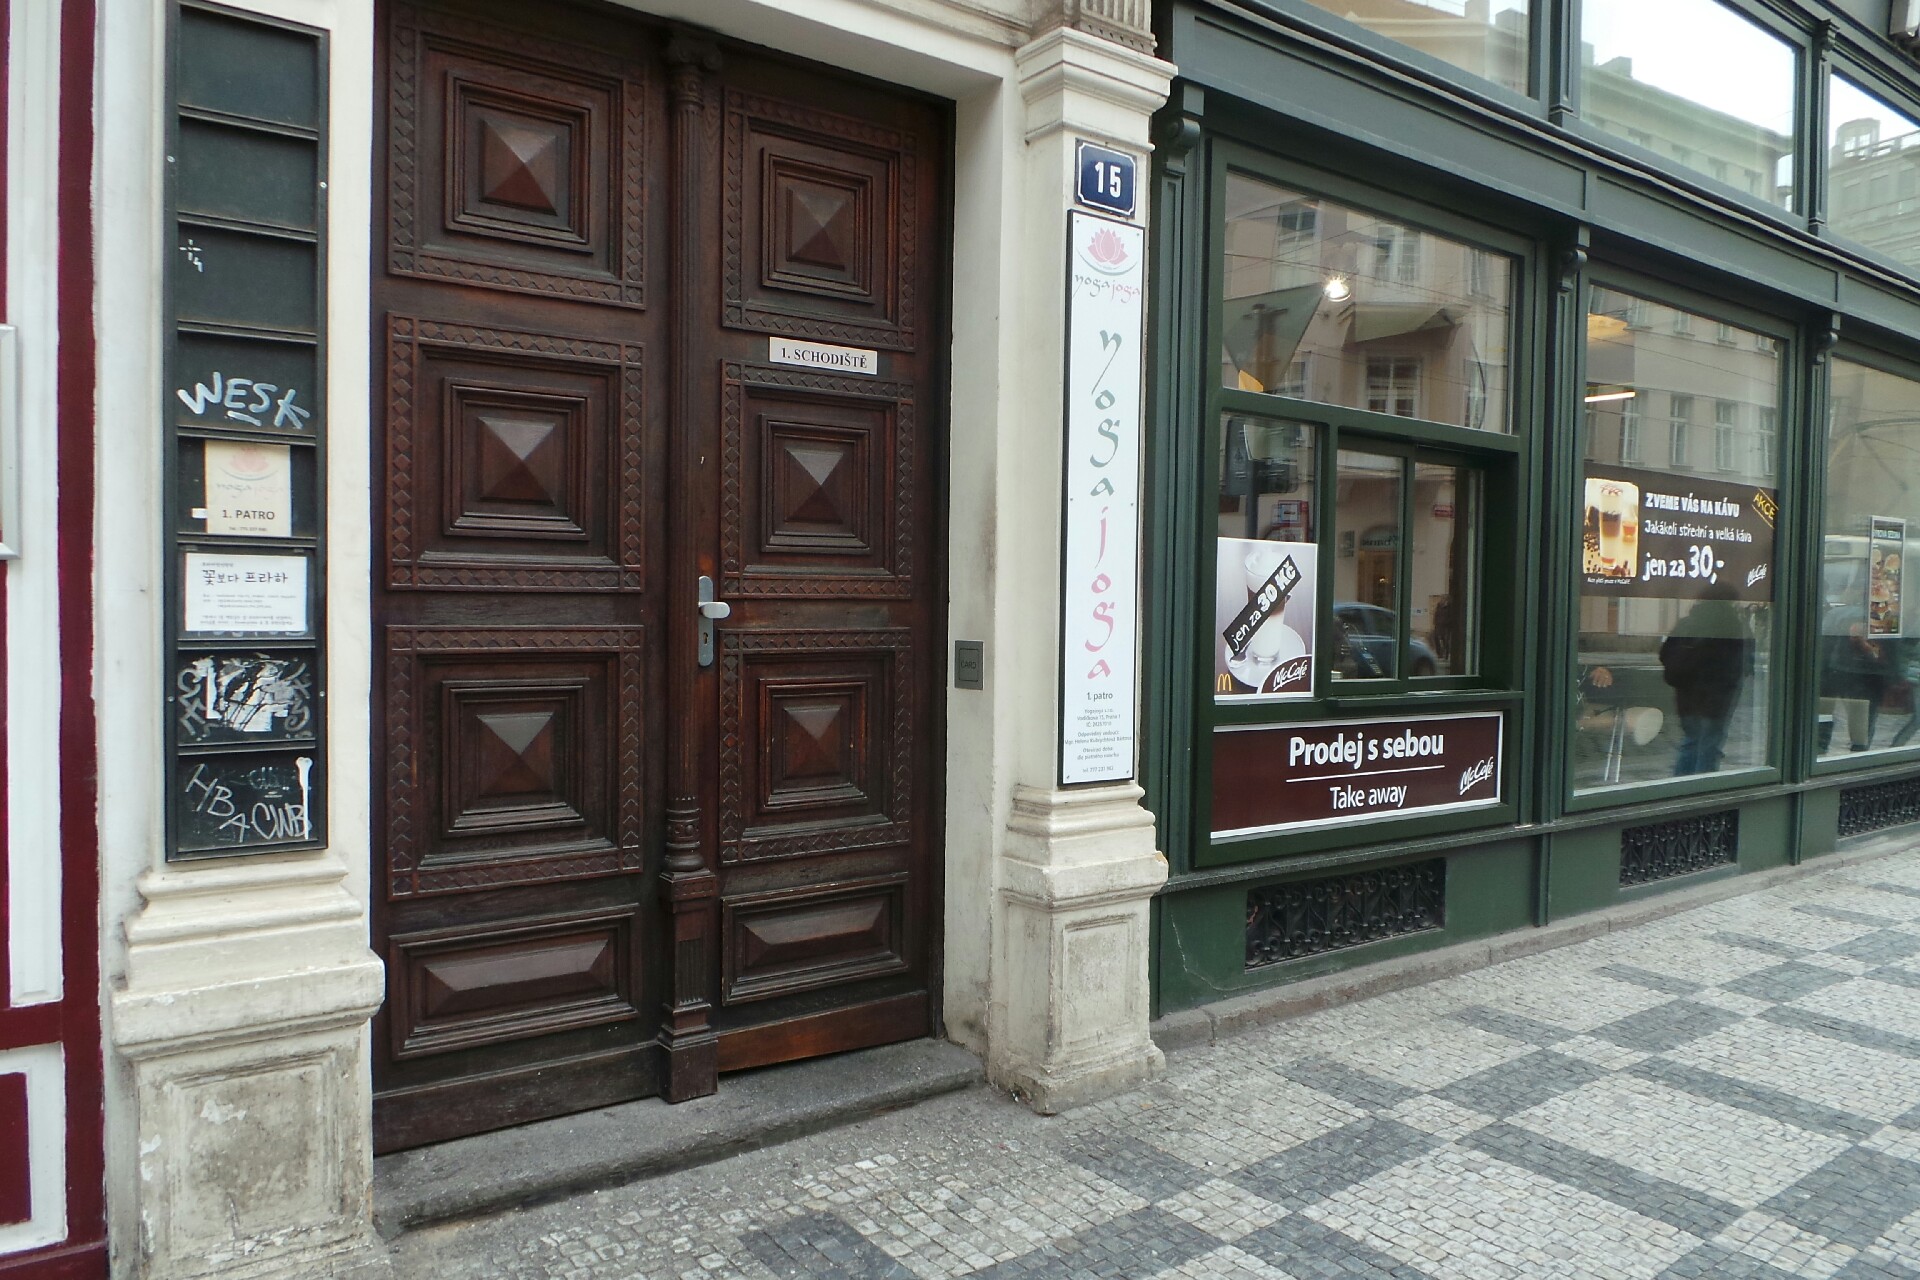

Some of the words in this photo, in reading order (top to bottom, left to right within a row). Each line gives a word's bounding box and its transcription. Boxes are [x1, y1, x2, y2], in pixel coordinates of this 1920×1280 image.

[1094, 161, 1122, 198] 15
[781, 347, 791, 359] 1.
[794, 348, 868, 369] SCHODIŠTĚ
[222, 509, 232, 519] 1.
[235, 509, 275, 520] PATRO
[1645, 492, 1680, 511] ZVEME
[1681, 492, 1700, 513] VÁS
[1700, 499, 1713, 515] NA
[1714, 497, 1740, 517] KÁVU
[1753, 493, 1776, 520] AKCE
[1644, 519, 1678, 537] Jakákoli
[1679, 523, 1708, 539] střední
[1709, 529, 1714, 540] a
[1715, 528, 1735, 541] velká
[1736, 529, 1752, 543] káva
[202, 569, 240, 586] 꽃보다
[245, 571, 288, 583] 프라하
[1642, 552, 1667, 581] jen
[1669, 559, 1686, 578] za
[1688, 545, 1725, 585] 30,-
[1230, 623, 1250, 652] jen
[1249, 610, 1262, 627] za
[1257, 583, 1278, 613] 30
[1274, 560, 1296, 591] Kč
[1272, 659, 1308, 690] McCafé
[1093, 692, 1113, 702] patro
[1289, 732, 1364, 770] Prodej
[1367, 739, 1378, 761] s
[1382, 728, 1444, 759] sebou
[1459, 756, 1494, 794] McCafé
[1329, 785, 1365, 810] Take
[1368, 784, 1408, 808] away
